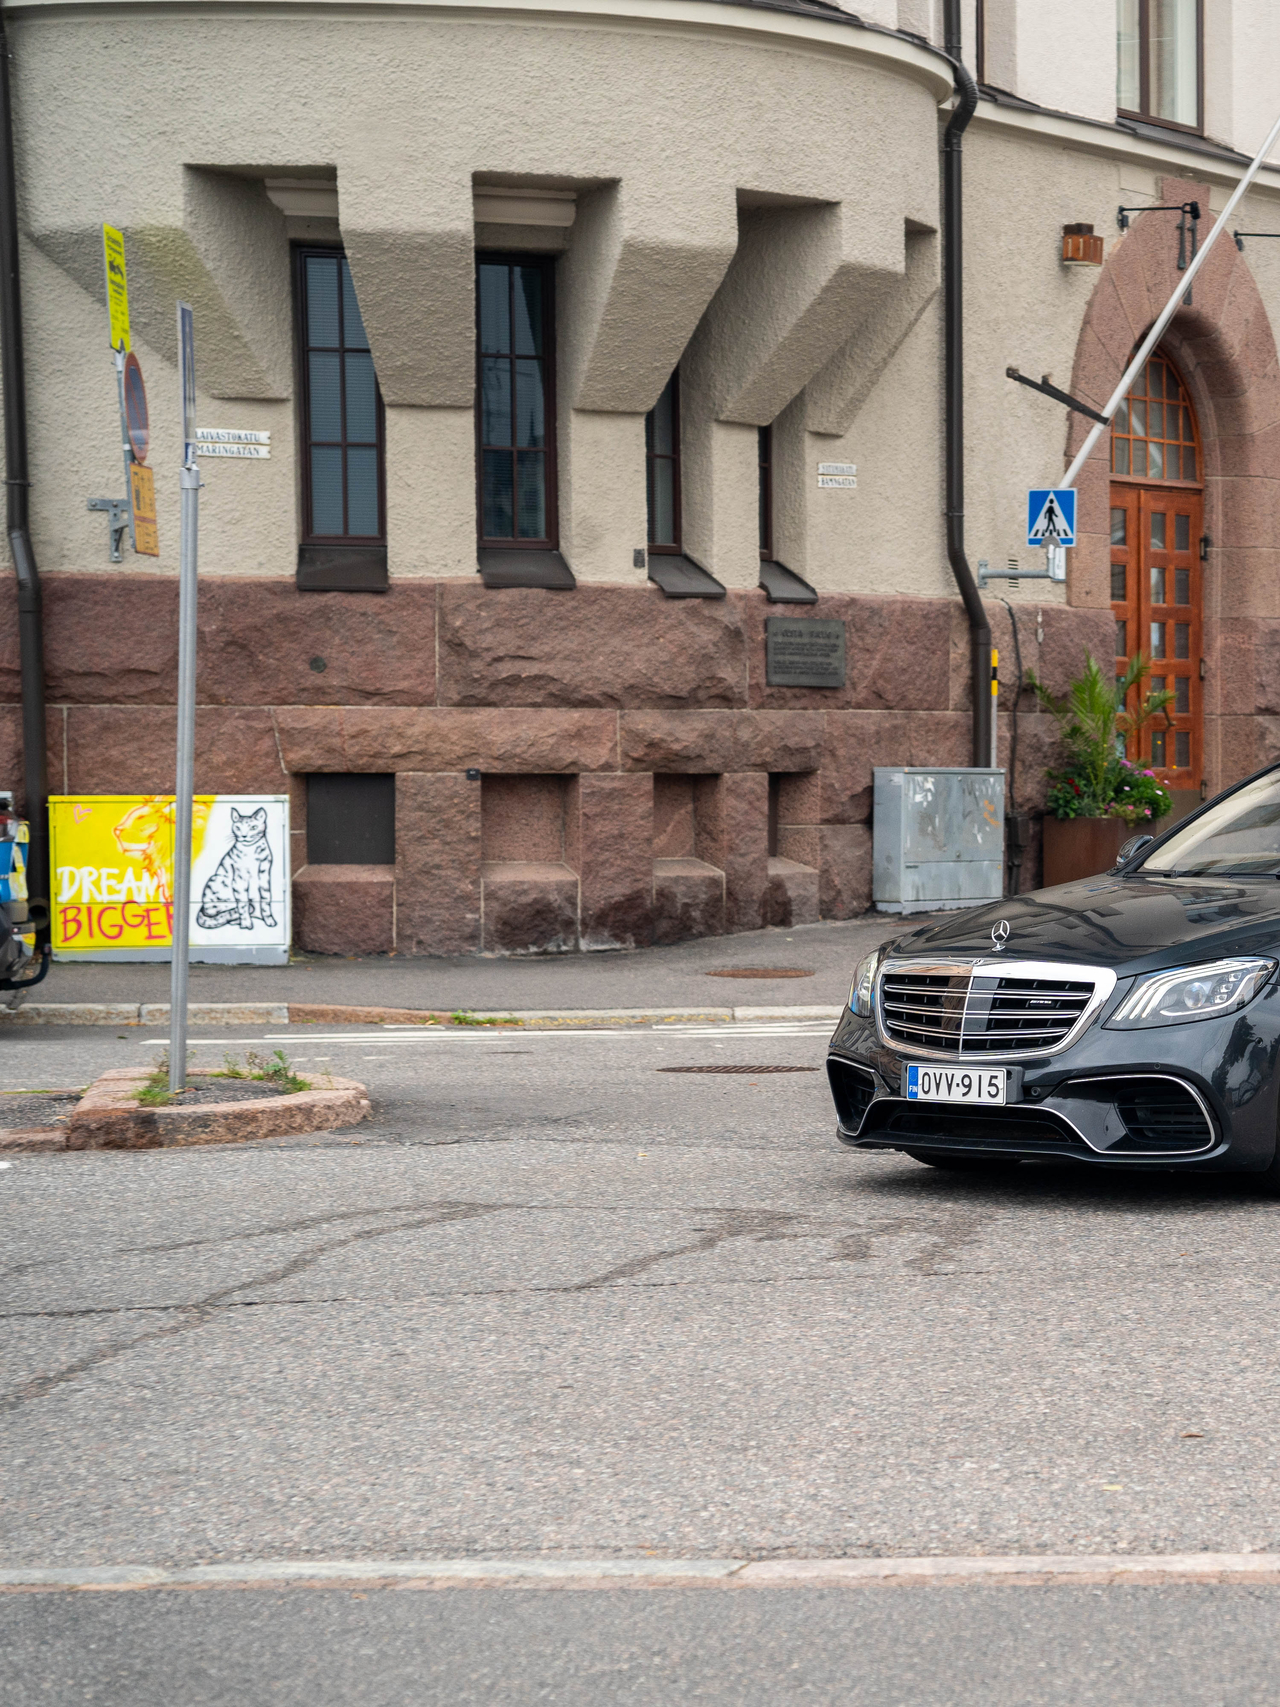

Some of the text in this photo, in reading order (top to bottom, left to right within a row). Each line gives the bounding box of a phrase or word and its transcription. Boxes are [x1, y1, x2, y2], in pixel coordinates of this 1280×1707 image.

[196, 431, 260, 442] LAIVASTOKATU
[196, 445, 260, 456] MARINGATAN
[56, 866, 168, 904] DREAM
[909, 1085, 918, 1093] FIN
[922, 1072, 1000, 1099] OVV-915
